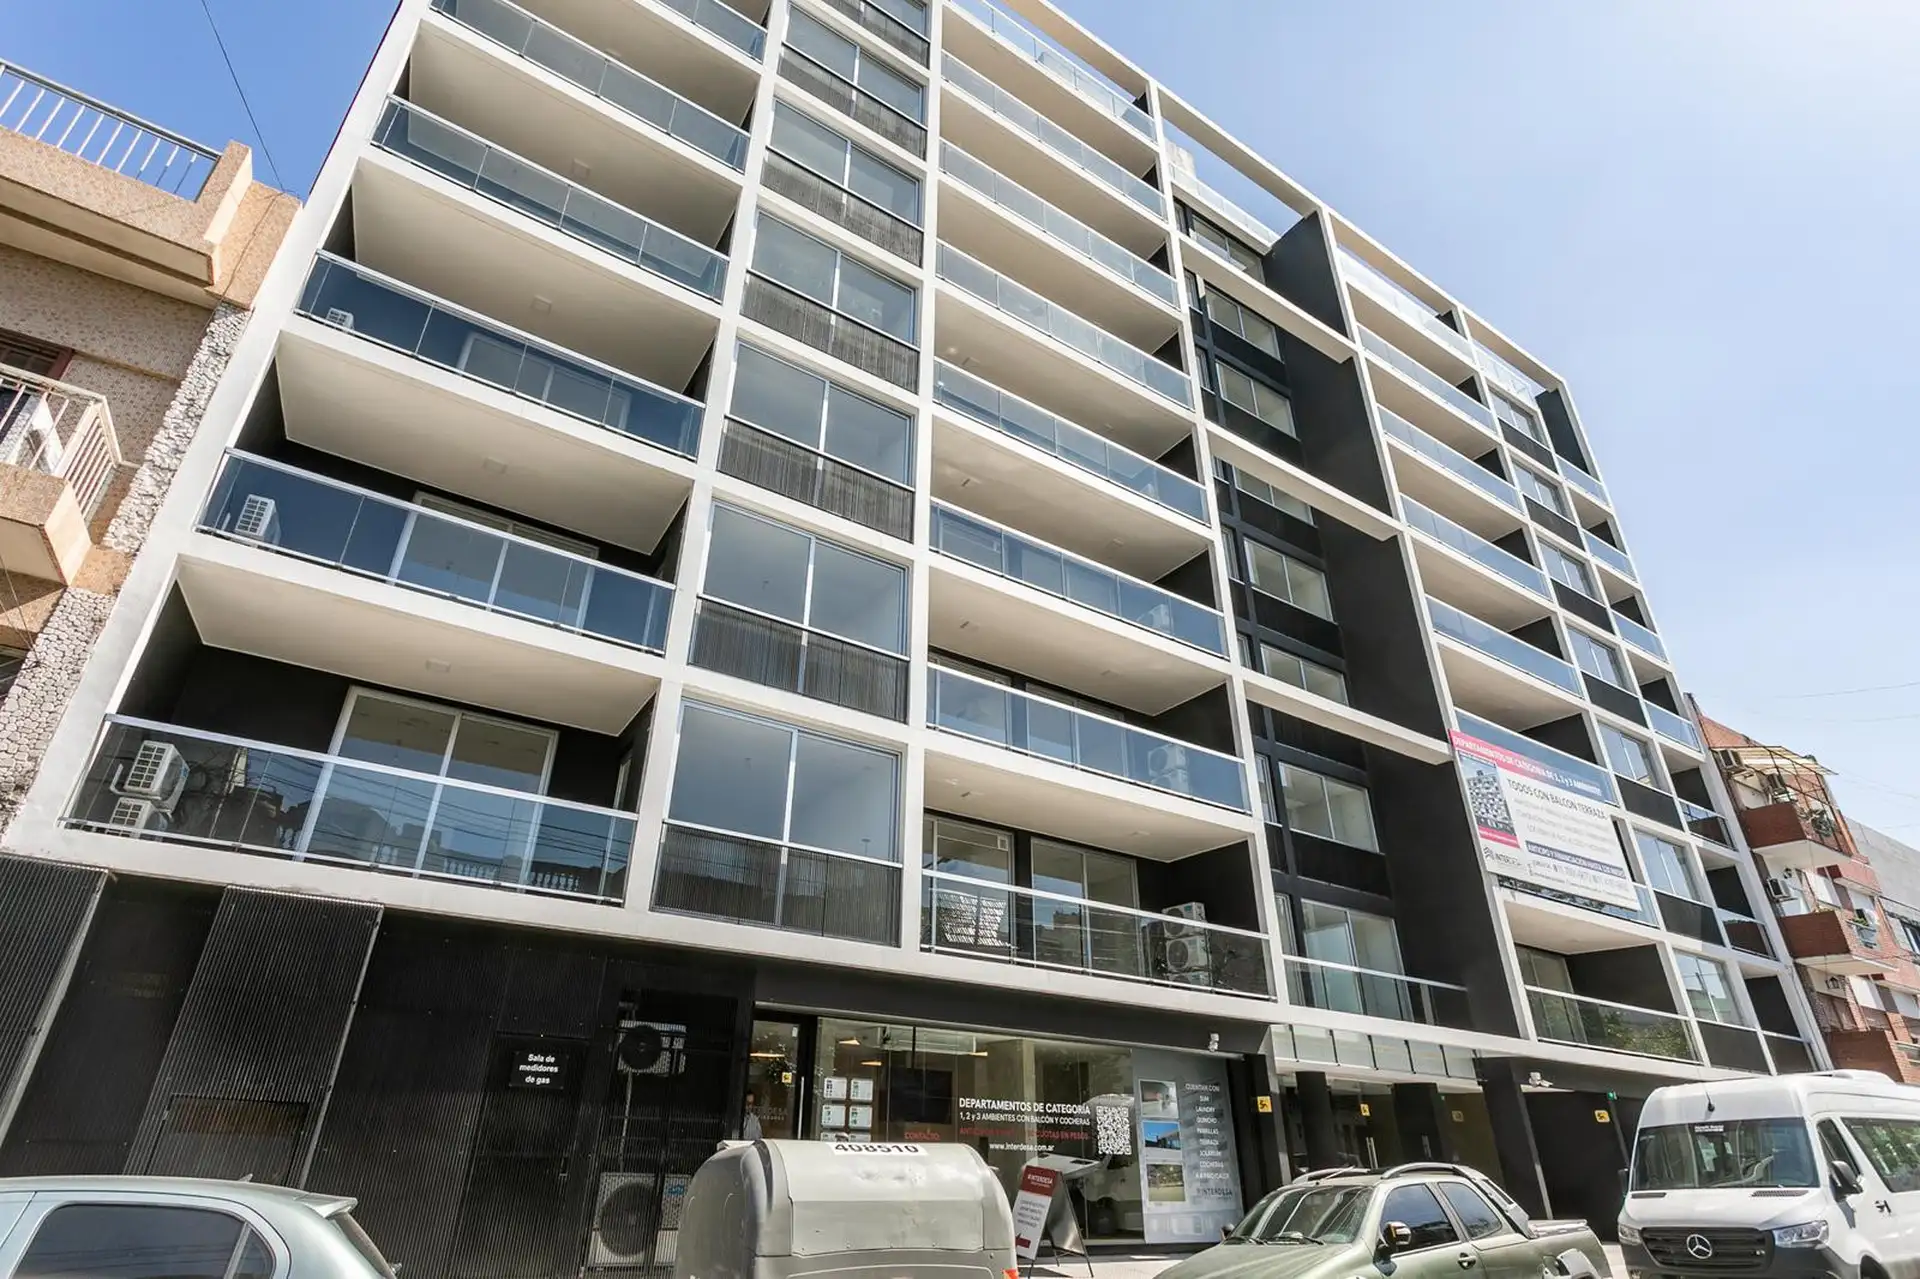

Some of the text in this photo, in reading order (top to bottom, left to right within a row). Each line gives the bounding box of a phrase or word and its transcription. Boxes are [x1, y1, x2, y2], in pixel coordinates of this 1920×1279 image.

[1507, 778, 1533, 796] TODOS
[1533, 785, 1551, 801] CON
[528, 1053, 556, 1063] Sala de
[519, 1064, 559, 1073] medidores
[525, 1075, 550, 1085] de gas
[959, 1097, 1091, 1115] DEPARTAMENTOS DE CATEGORÍA
[960, 1113, 966, 1121] 1,
[976, 1113, 981, 1121] 3
[981, 1113, 1016, 1123] AMBIENTES
[1017, 1115, 1030, 1123] CON
[1054, 1116, 1060, 1124] Y
[1060, 1116, 1091, 1126] COCHERAS
[835, 1143, 919, 1153] 408510
